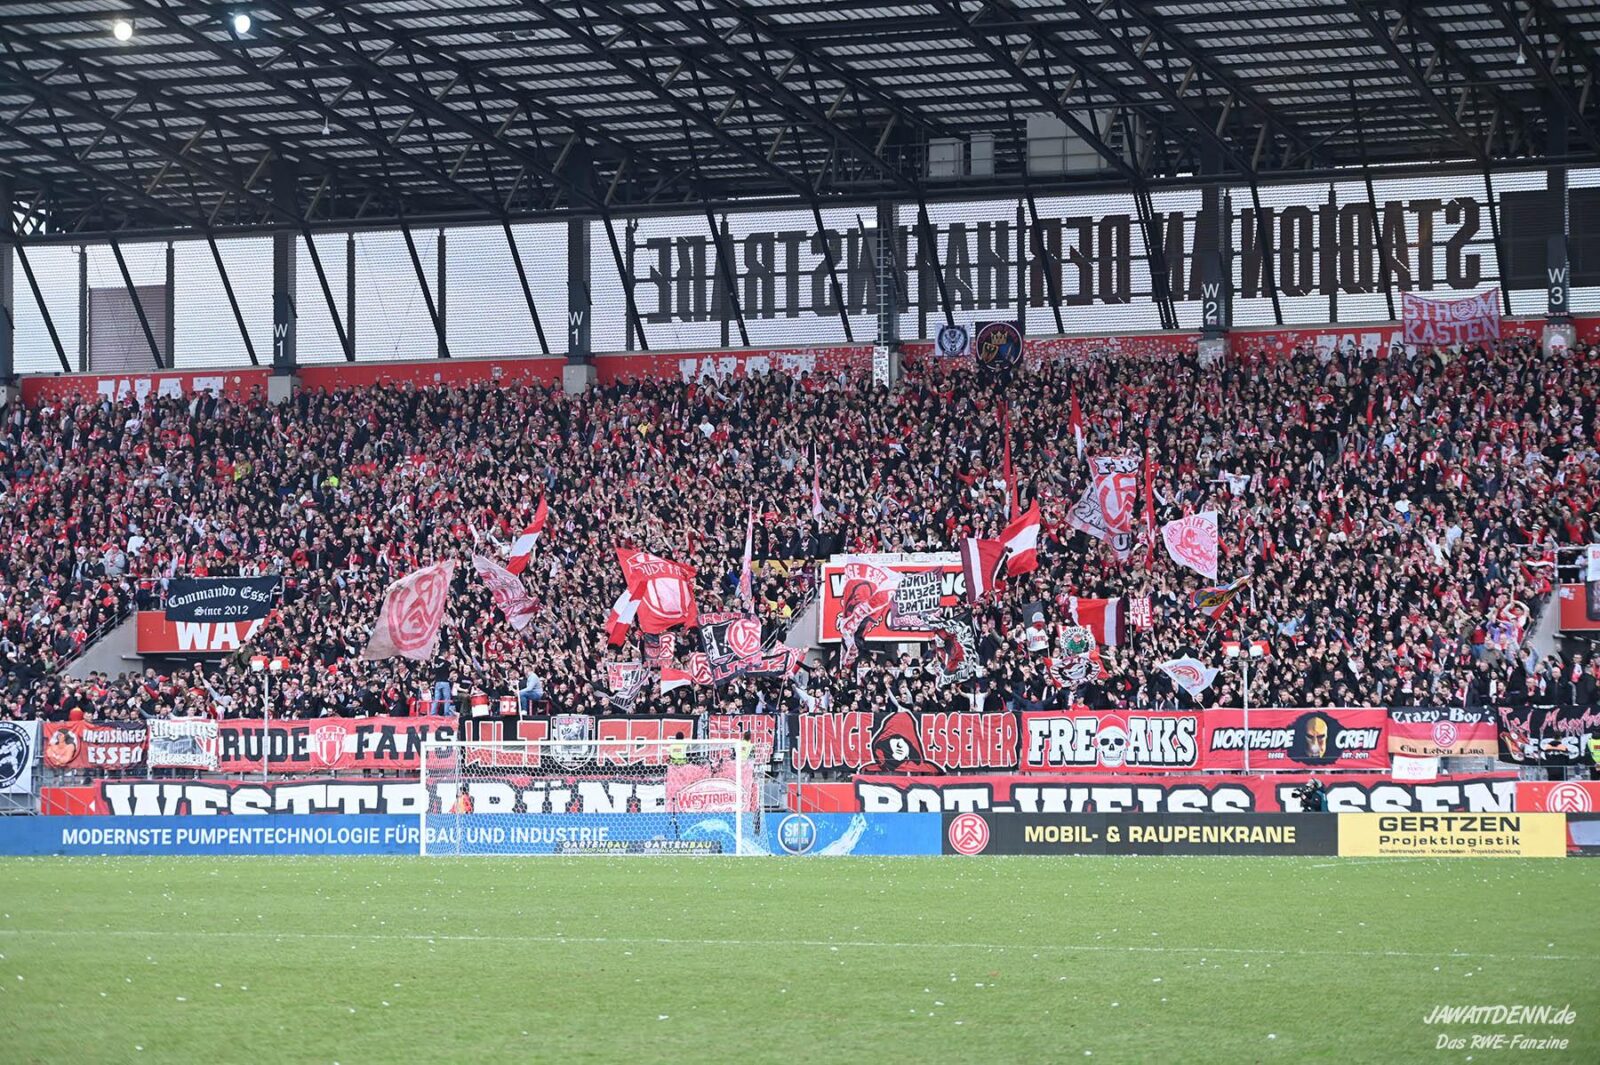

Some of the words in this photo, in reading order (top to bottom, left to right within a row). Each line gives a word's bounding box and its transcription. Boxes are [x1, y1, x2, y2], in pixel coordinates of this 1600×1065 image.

[1547, 268, 1565, 283] W
[1203, 284, 1219, 298] W
[1550, 287, 1564, 305] 3
[568, 311, 583, 326] W
[1205, 303, 1217, 319] 2
[273, 323, 288, 338] W
[572, 329, 581, 345] 1
[1404, 315, 1500, 344] KASTEN
[276, 341, 285, 356] 1
[168, 584, 236, 608] Commando
[194, 606, 222, 616] Since
[224, 605, 249, 615] 2012
[222, 727, 310, 762] RUDE
[355, 725, 456, 762] FANS
[792, 712, 875, 770] JUNGE
[920, 712, 1018, 769] ESSENER
[1028, 717, 1197, 767] FREAKS
[1212, 729, 1295, 750] NORTHSIDE
[1335, 730, 1379, 749] CREW
[1379, 816, 1520, 832] GERTZEN
[62, 828, 172, 845] MODERNSTE
[176, 827, 380, 845] PUMPENTECHNOLOGIE
[384, 824, 421, 844] FÜR
[466, 827, 505, 844] UND
[511, 826, 609, 843] INDUSTRIE
[1024, 825, 1098, 843] MOBIL-
[1106, 826, 1120, 843] &
[1128, 825, 1296, 844] RAUPENKRANE
[1379, 836, 1520, 847] Projektlogistik
